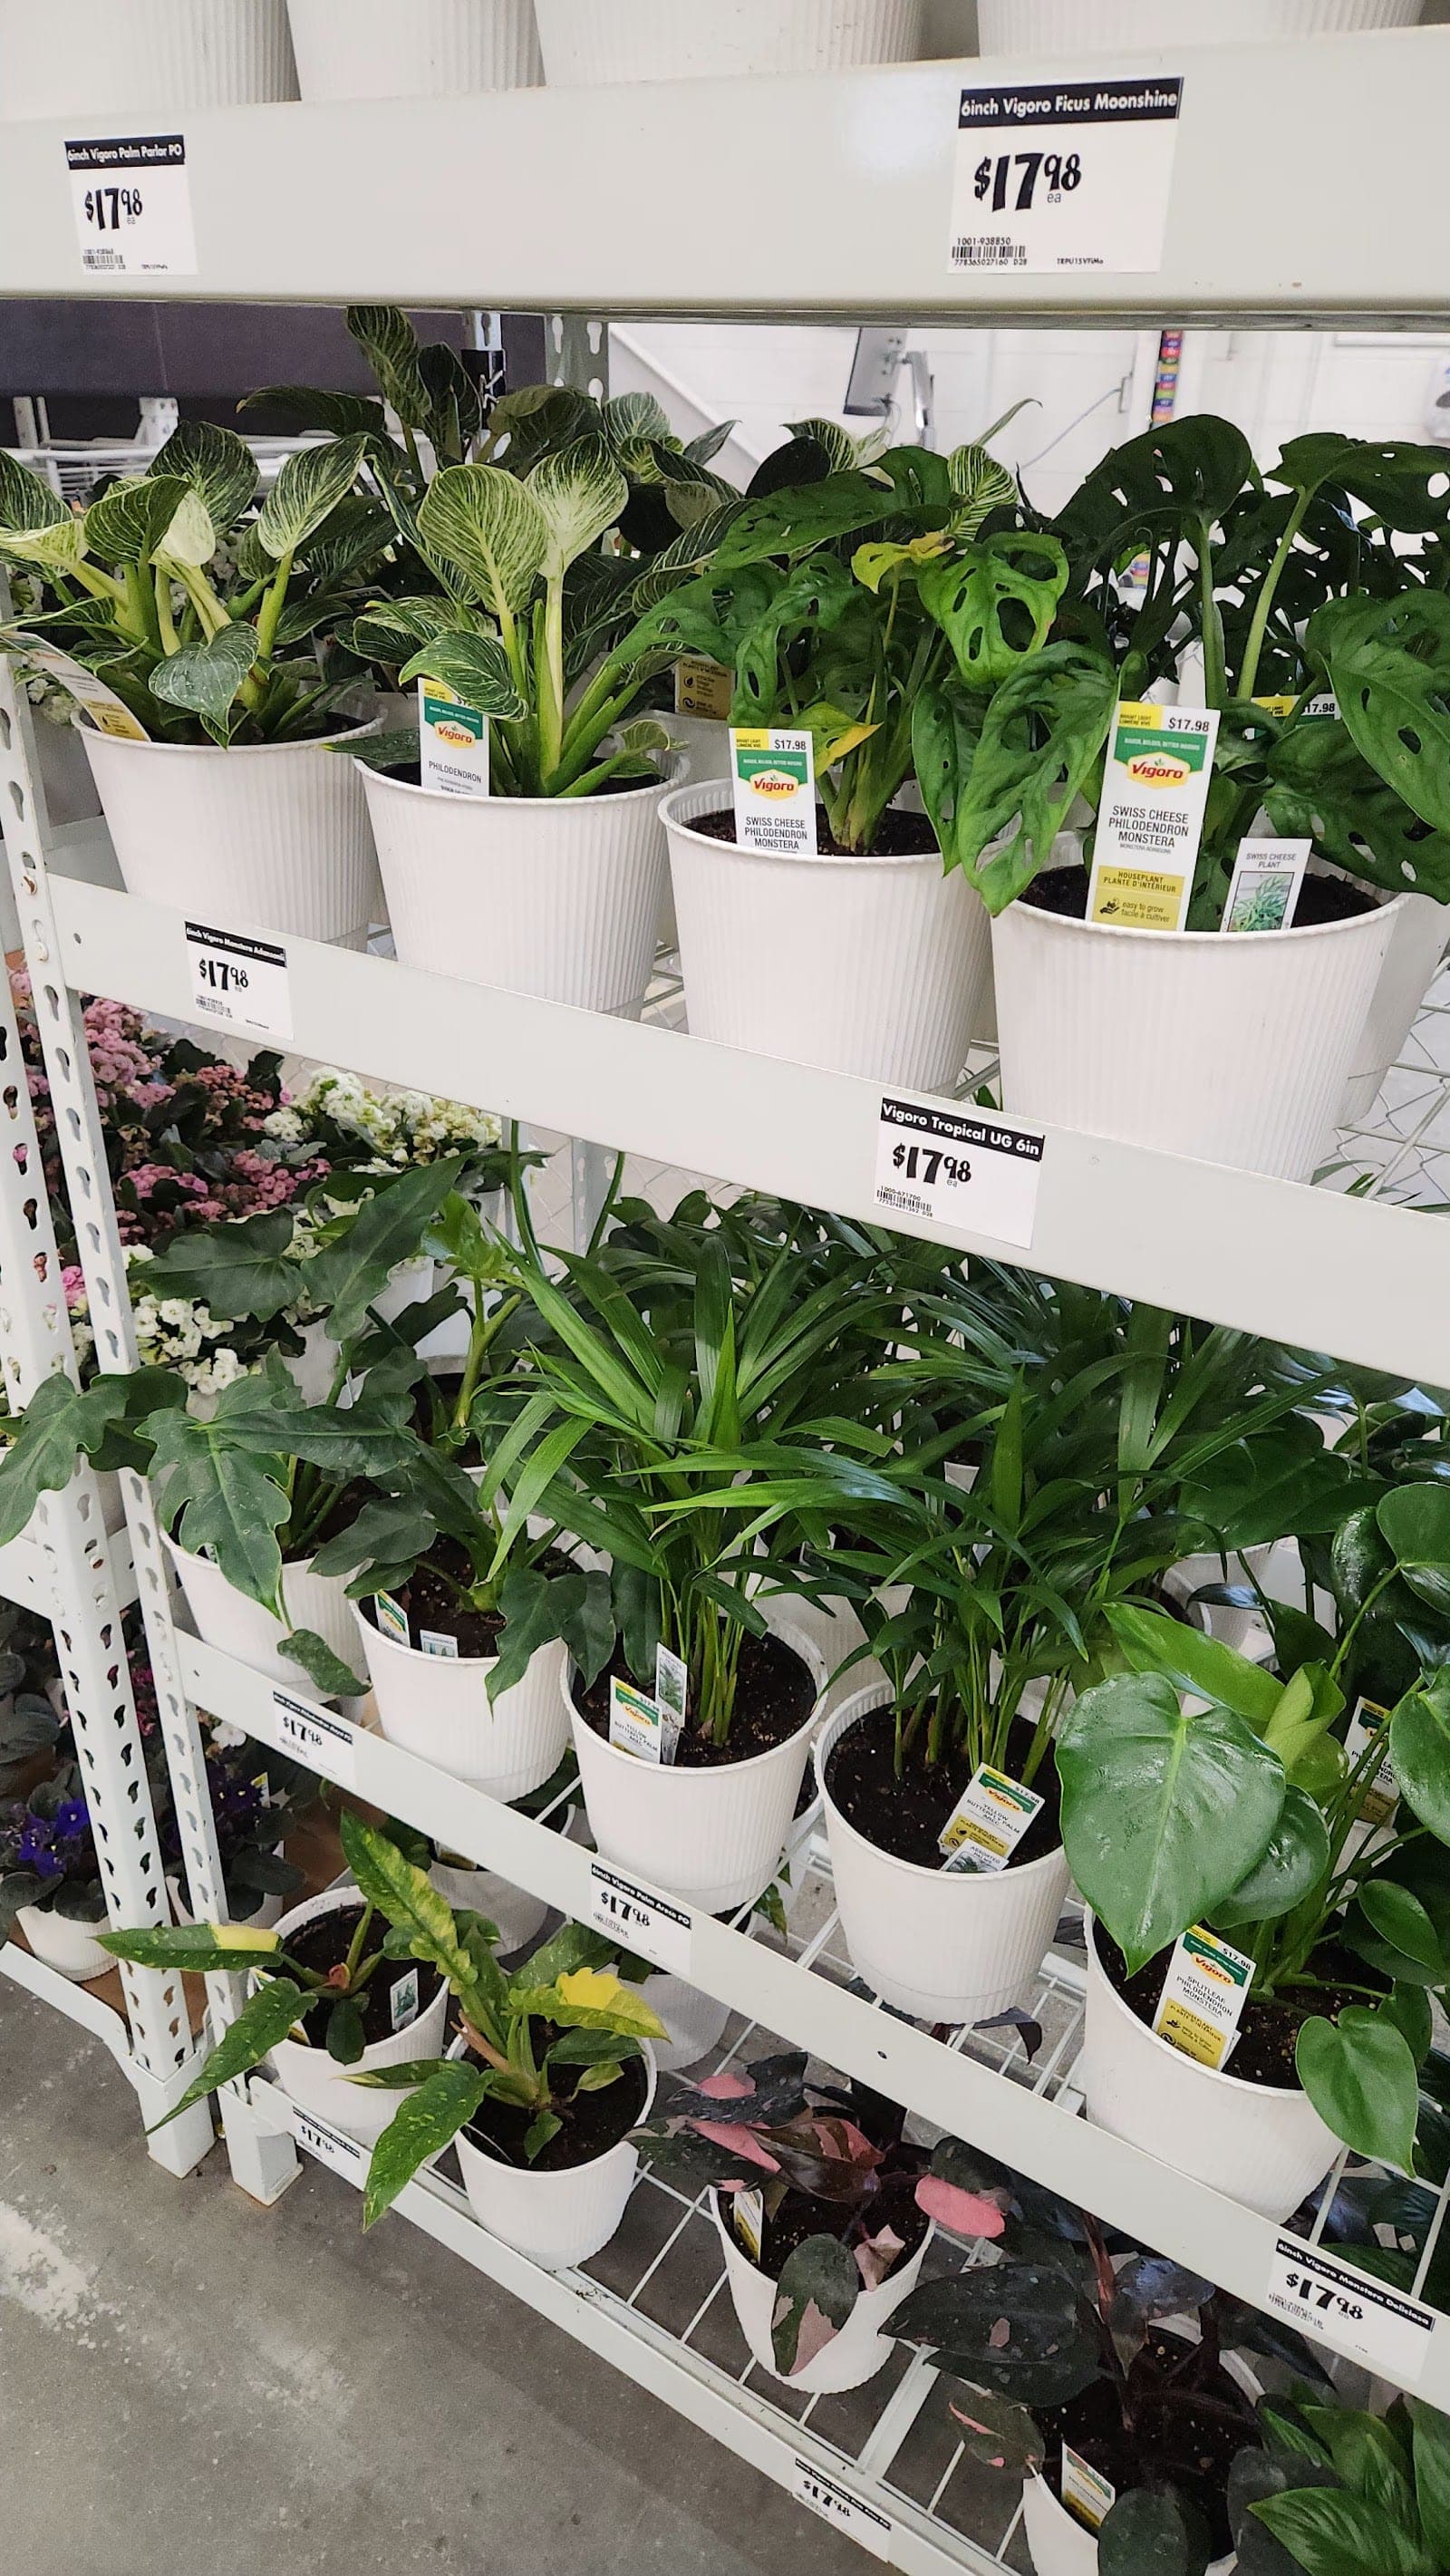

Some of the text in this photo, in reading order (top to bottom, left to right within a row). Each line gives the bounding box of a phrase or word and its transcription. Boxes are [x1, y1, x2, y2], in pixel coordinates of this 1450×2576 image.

[961, 90, 1177, 118] 6inch Vigoro Ficus Moonshine
[90, 148, 118, 163] Vigoro
[119, 146, 140, 159] Palm
[169, 143, 182, 156] PO
[1047, 193, 1061, 203] ea
[1302, 703, 1335, 713] 17.98
[1168, 717, 1210, 732] $17.98
[438, 726, 472, 743] Vigoro
[775, 739, 807, 751] $17.98
[429, 760, 481, 783] PHILODENDRON
[1132, 760, 1184, 780] Vigoro
[754, 778, 795, 792] Vigoro
[1112, 805, 1189, 824] SWISS CHEESE
[746, 816, 806, 829] SWISS CHEESE
[1108, 817, 1189, 837] PHILODENDRON
[745, 827, 807, 839] PHILODENDRON
[1118, 831, 1175, 847] MONSTERA
[754, 838, 799, 849] MONSTERA
[1269, 853, 1297, 861] CHEESE
[1103, 876, 1130, 886] PLANTE
[1118, 871, 1164, 884] HOUSEPLANT
[1122, 902, 1138, 910] easy
[1146, 913, 1170, 923] cultiver
[883, 1103, 1039, 1156] Vigoro Tropical UG 6in
[947, 1178, 958, 1187] ea
[1195, 1956, 1231, 1984] Vigoro
[1176, 1975, 1233, 2017] PHILODENDRON
[1187, 1975, 1225, 2004] SPLITLEAF
[1182, 1987, 1223, 2018] MONSTERA
[1305, 2255, 1337, 2278] Vigoro
[1339, 2273, 1384, 2302] Monstera
[1386, 2298, 1430, 2326] Deliciosa
